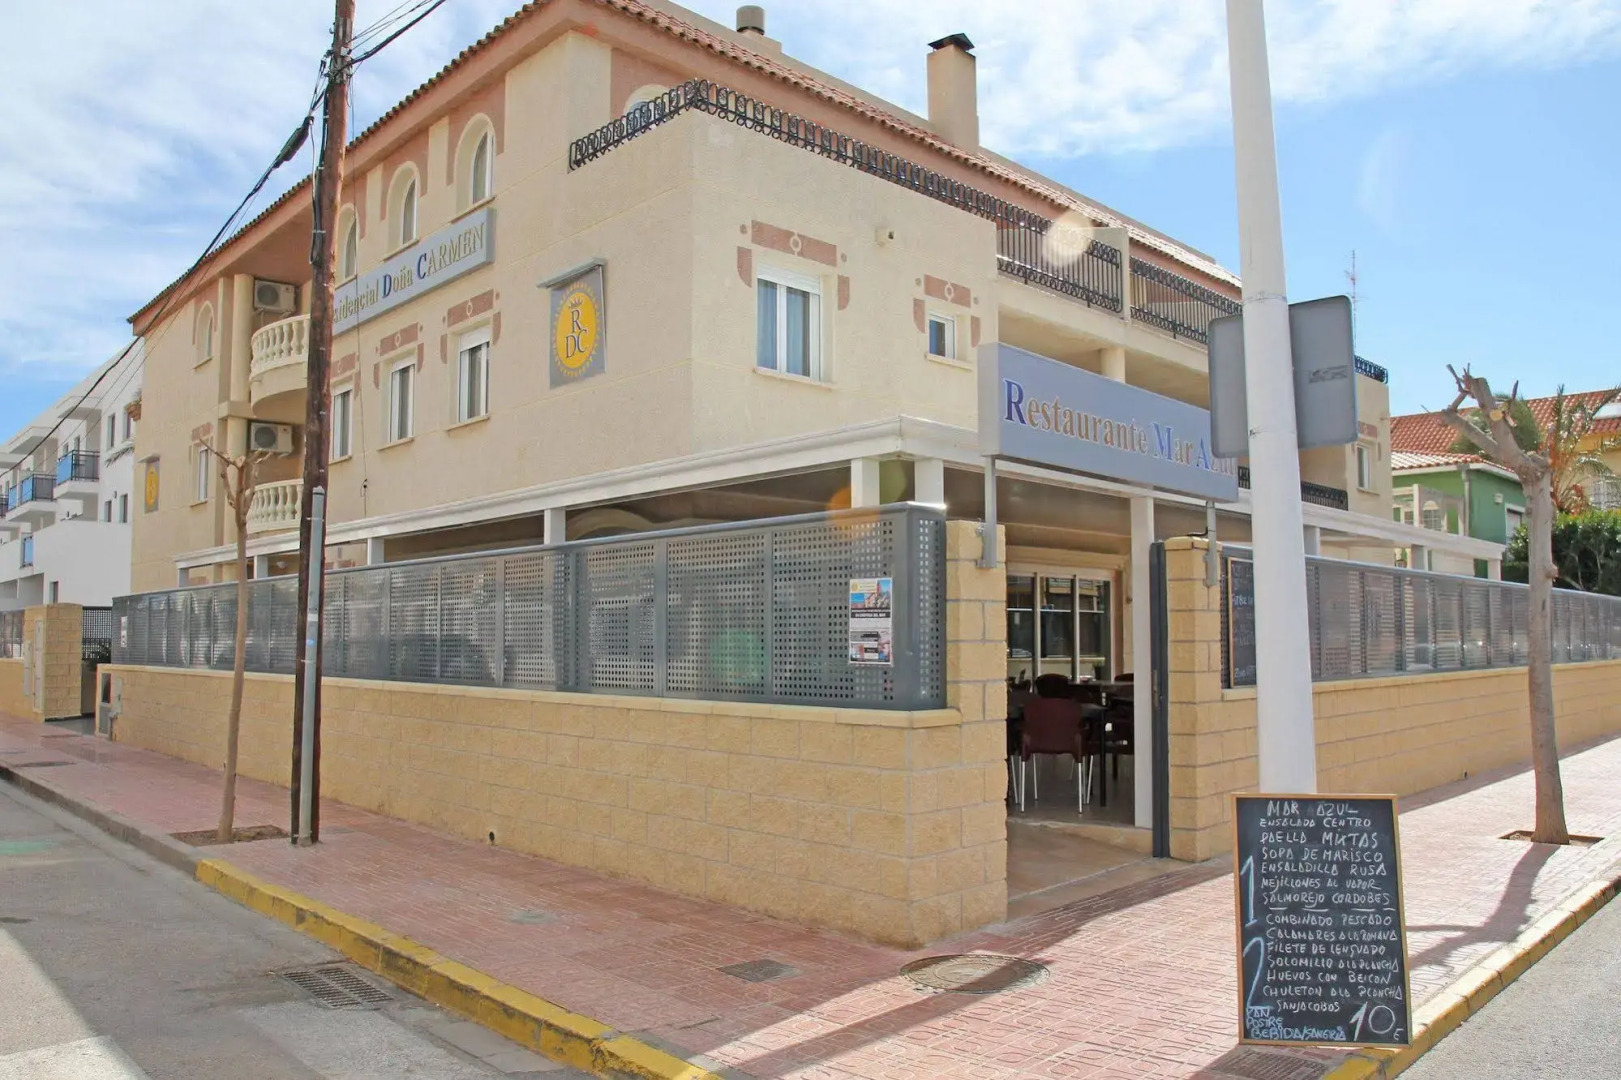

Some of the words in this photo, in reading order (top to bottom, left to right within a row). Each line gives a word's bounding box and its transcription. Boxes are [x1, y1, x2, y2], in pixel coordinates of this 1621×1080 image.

[334, 279, 379, 323] sidencial
[382, 266, 413, 299] Doña
[417, 223, 485, 280] CARMEN
[571, 309, 582, 334] R
[1003, 378, 1149, 454] Restaurante
[1151, 422, 1194, 467] Mar
[1267, 800, 1300, 816] MAR
[1316, 803, 1358, 816] AZUL
[1259, 818, 1316, 827] ENSALADA
[1323, 817, 1371, 828] CENTRO
[1260, 831, 1307, 844] PAELLA
[1262, 848, 1294, 860] SOPA
[1302, 848, 1318, 861] DE
[1261, 861, 1339, 876] ENSALADILLA
[1350, 863, 1387, 876] RUSA
[1345, 878, 1382, 890] VAPOR
[1263, 892, 1325, 908] SALMOREJO
[1331, 892, 1390, 906] CORDOBES
[1266, 913, 1333, 927] COMBINADO
[1341, 914, 1392, 926] PESCADO
[1266, 927, 1336, 941] CALAMARES
[1311, 943, 1326, 955] DE
[1266, 970, 1312, 982] HUEVOS
[1318, 972, 1338, 982] CON
[1348, 971, 1392, 984] BEICON
[1262, 985, 1322, 997] CHULETON
[1358, 985, 1403, 1000] PLANCHA
[1246, 1007, 1271, 1018] PAN
[1246, 1017, 1284, 1028] POSTRE
